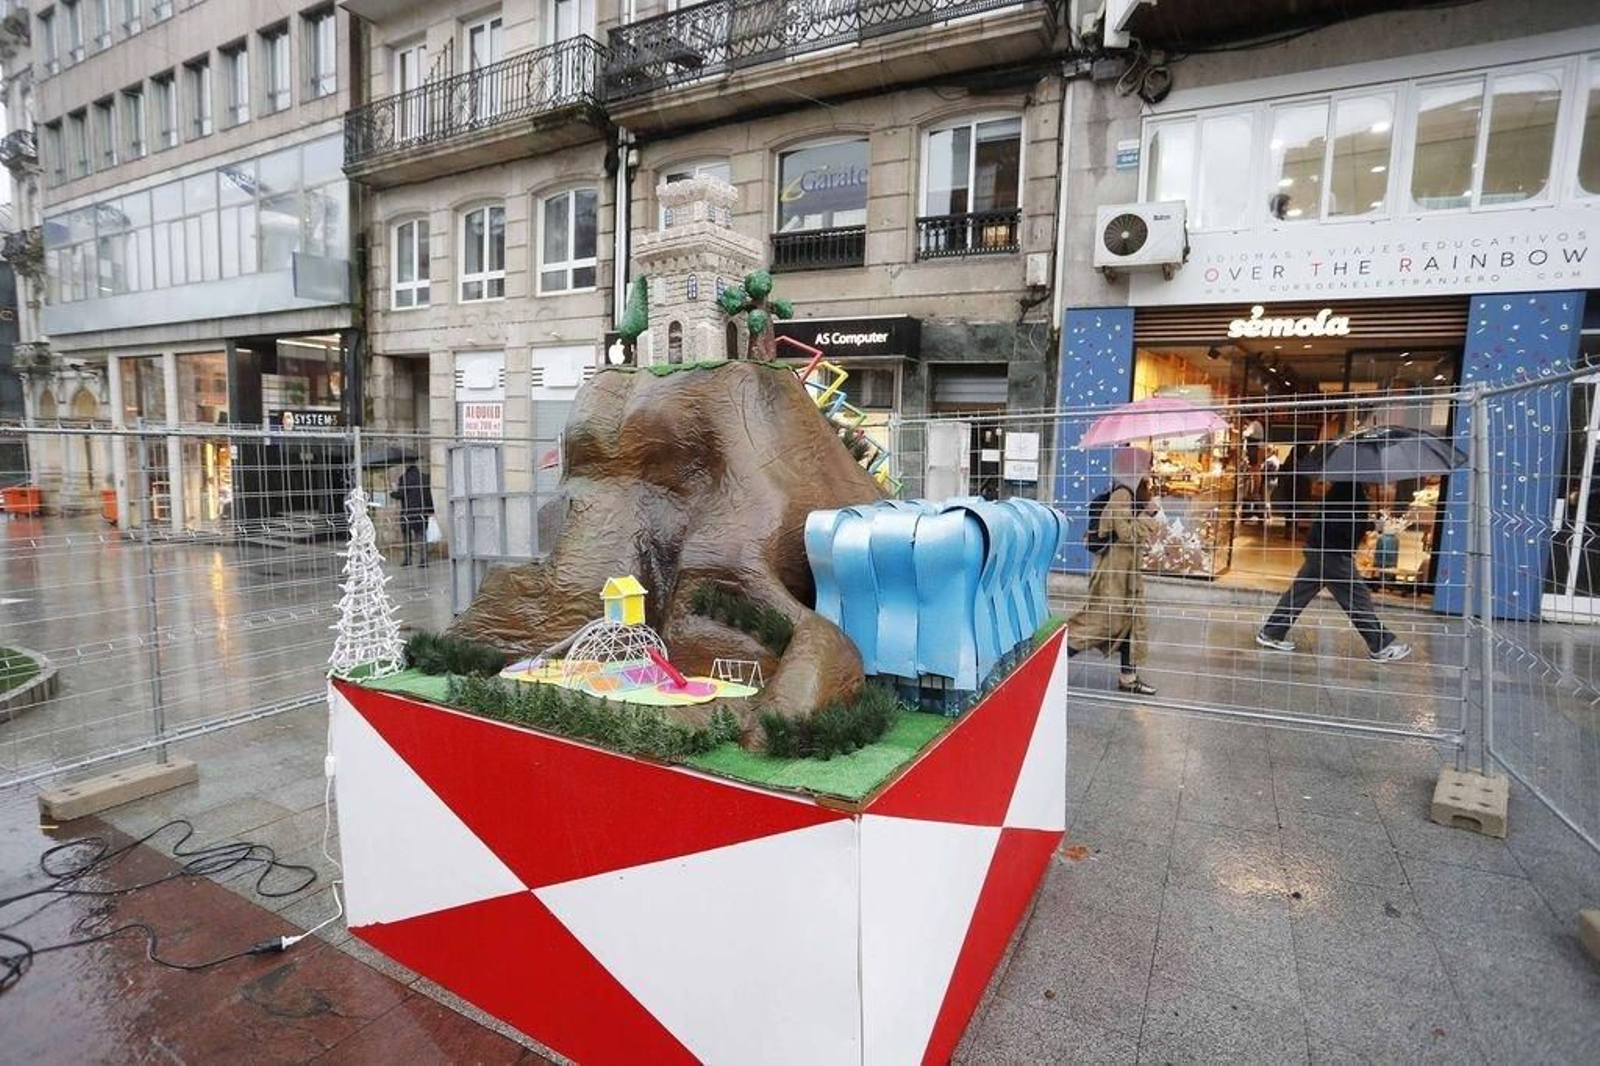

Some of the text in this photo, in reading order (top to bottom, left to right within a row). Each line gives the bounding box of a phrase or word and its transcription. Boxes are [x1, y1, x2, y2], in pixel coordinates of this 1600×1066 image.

[1207, 230, 1588, 263] IDIOMAS Y VIAJES EDUCATIVOS
[1204, 246, 1589, 283] OVER THE RAINBOW
[815, 332, 889, 347] AS Computer
